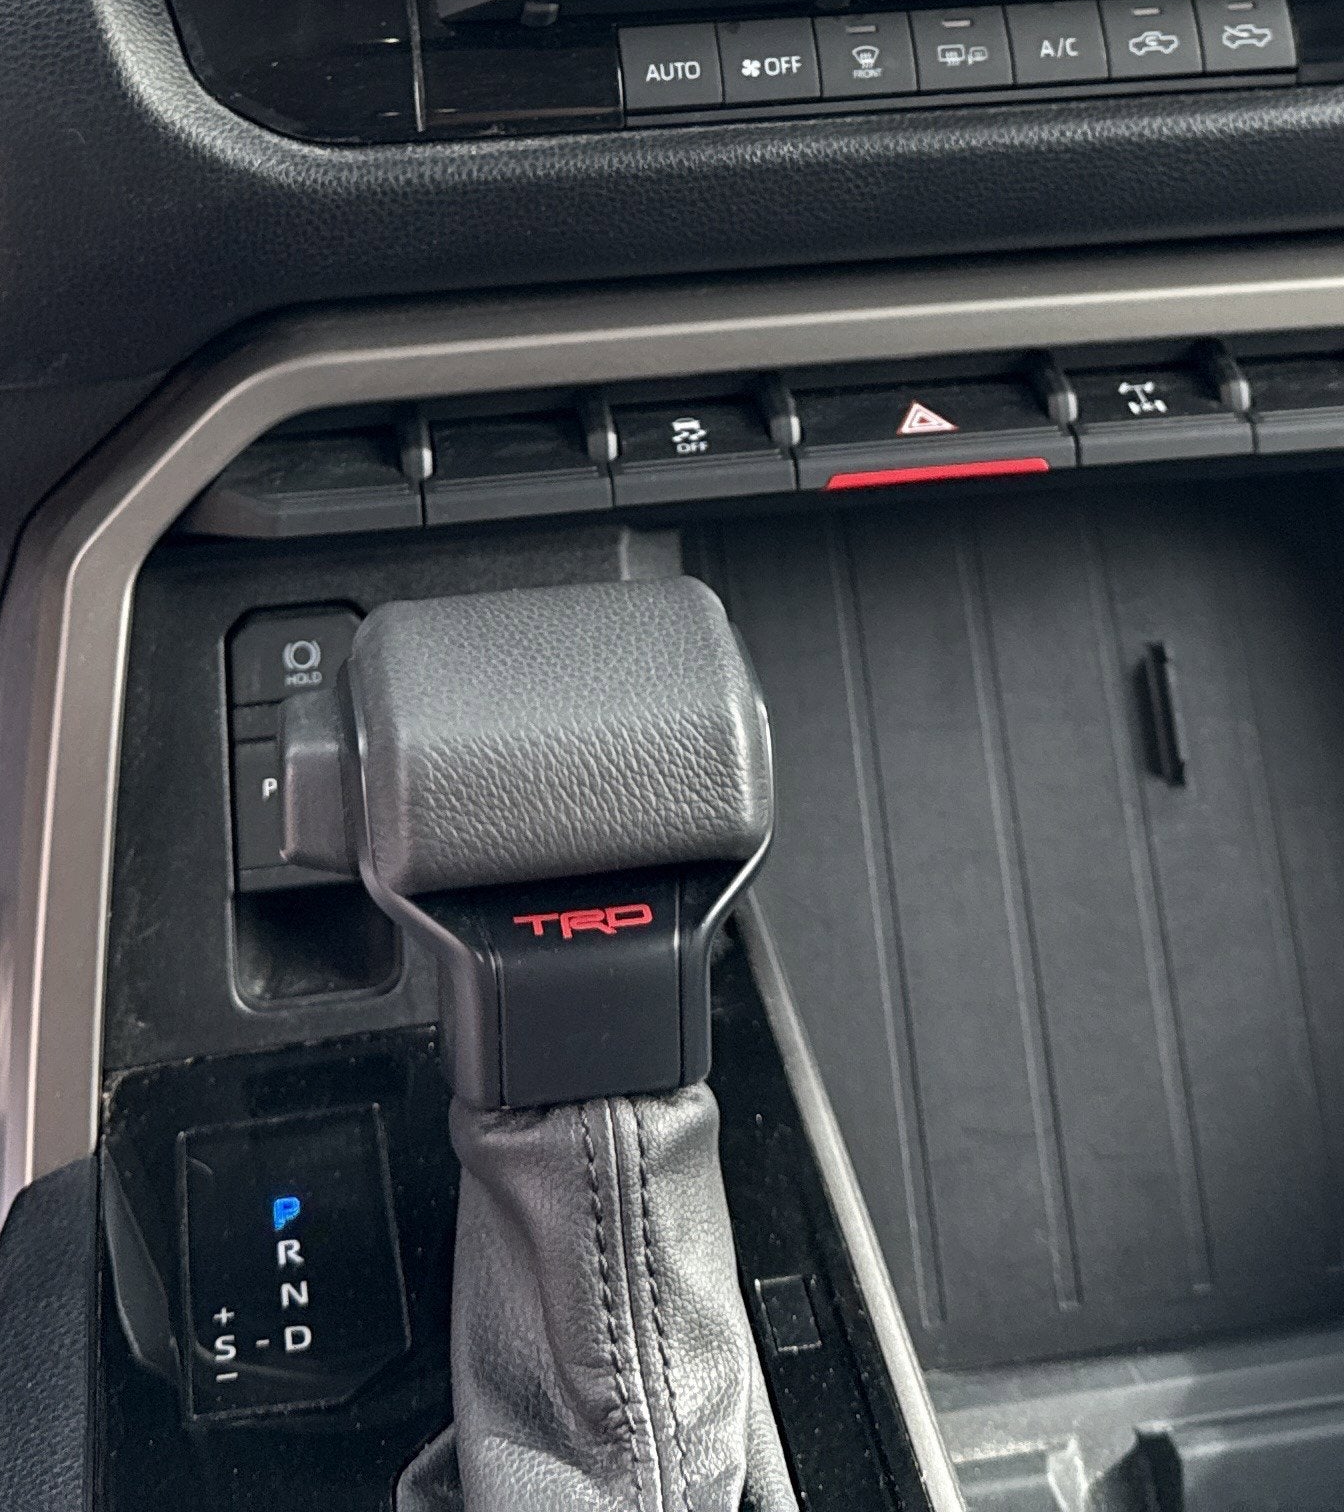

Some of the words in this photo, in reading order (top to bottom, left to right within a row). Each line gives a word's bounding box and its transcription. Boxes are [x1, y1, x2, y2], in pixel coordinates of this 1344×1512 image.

[1040, 35, 1079, 60] A/C
[645, 58, 702, 82] AUTO
[764, 54, 802, 77] OFF
[676, 440, 708, 455] OFF
[284, 671, 323, 687] HOLD
[262, 777, 278, 800] P
[512, 903, 654, 940] TRD
[272, 1195, 301, 1232] P
[276, 1239, 305, 1269] R
[279, 1280, 309, 1310] N
[214, 1334, 238, 1362] S
[283, 1324, 312, 1354] D
